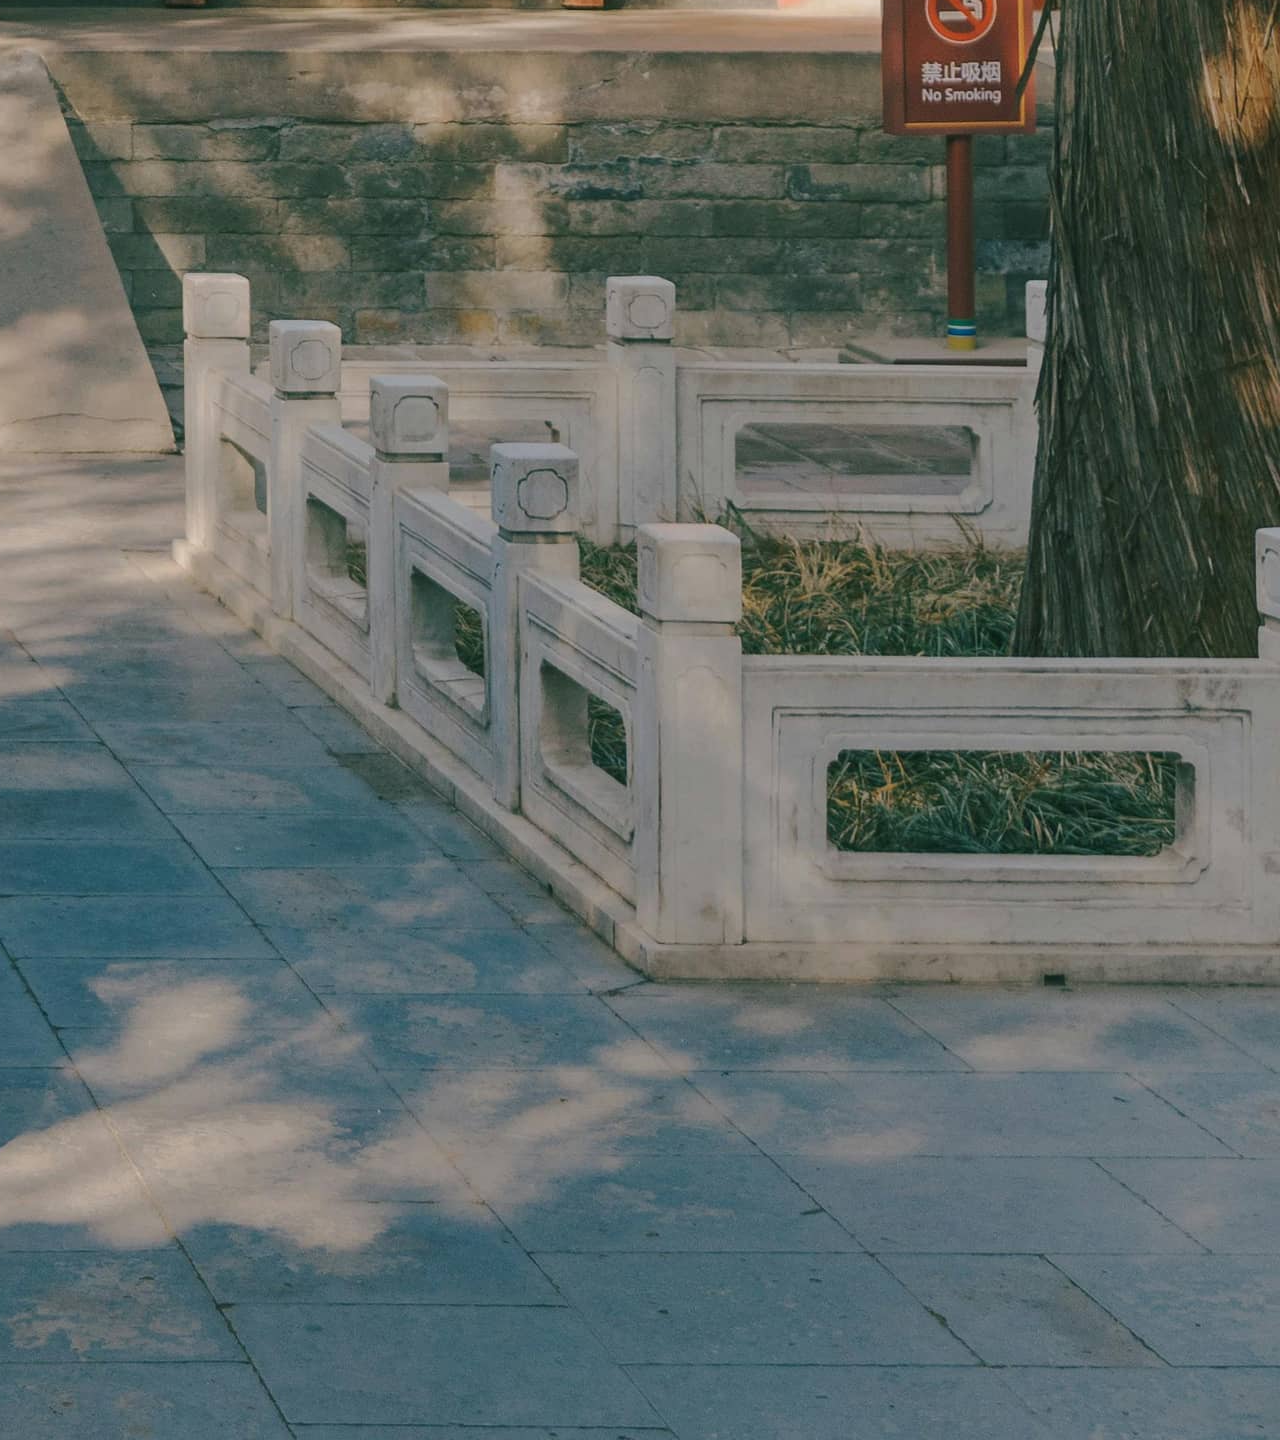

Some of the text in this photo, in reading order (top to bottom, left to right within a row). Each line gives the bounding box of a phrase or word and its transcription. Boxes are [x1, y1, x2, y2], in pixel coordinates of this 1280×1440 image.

[922, 61, 1001, 83] 禁止吸烟
[922, 88, 1001, 105] No Smoking
